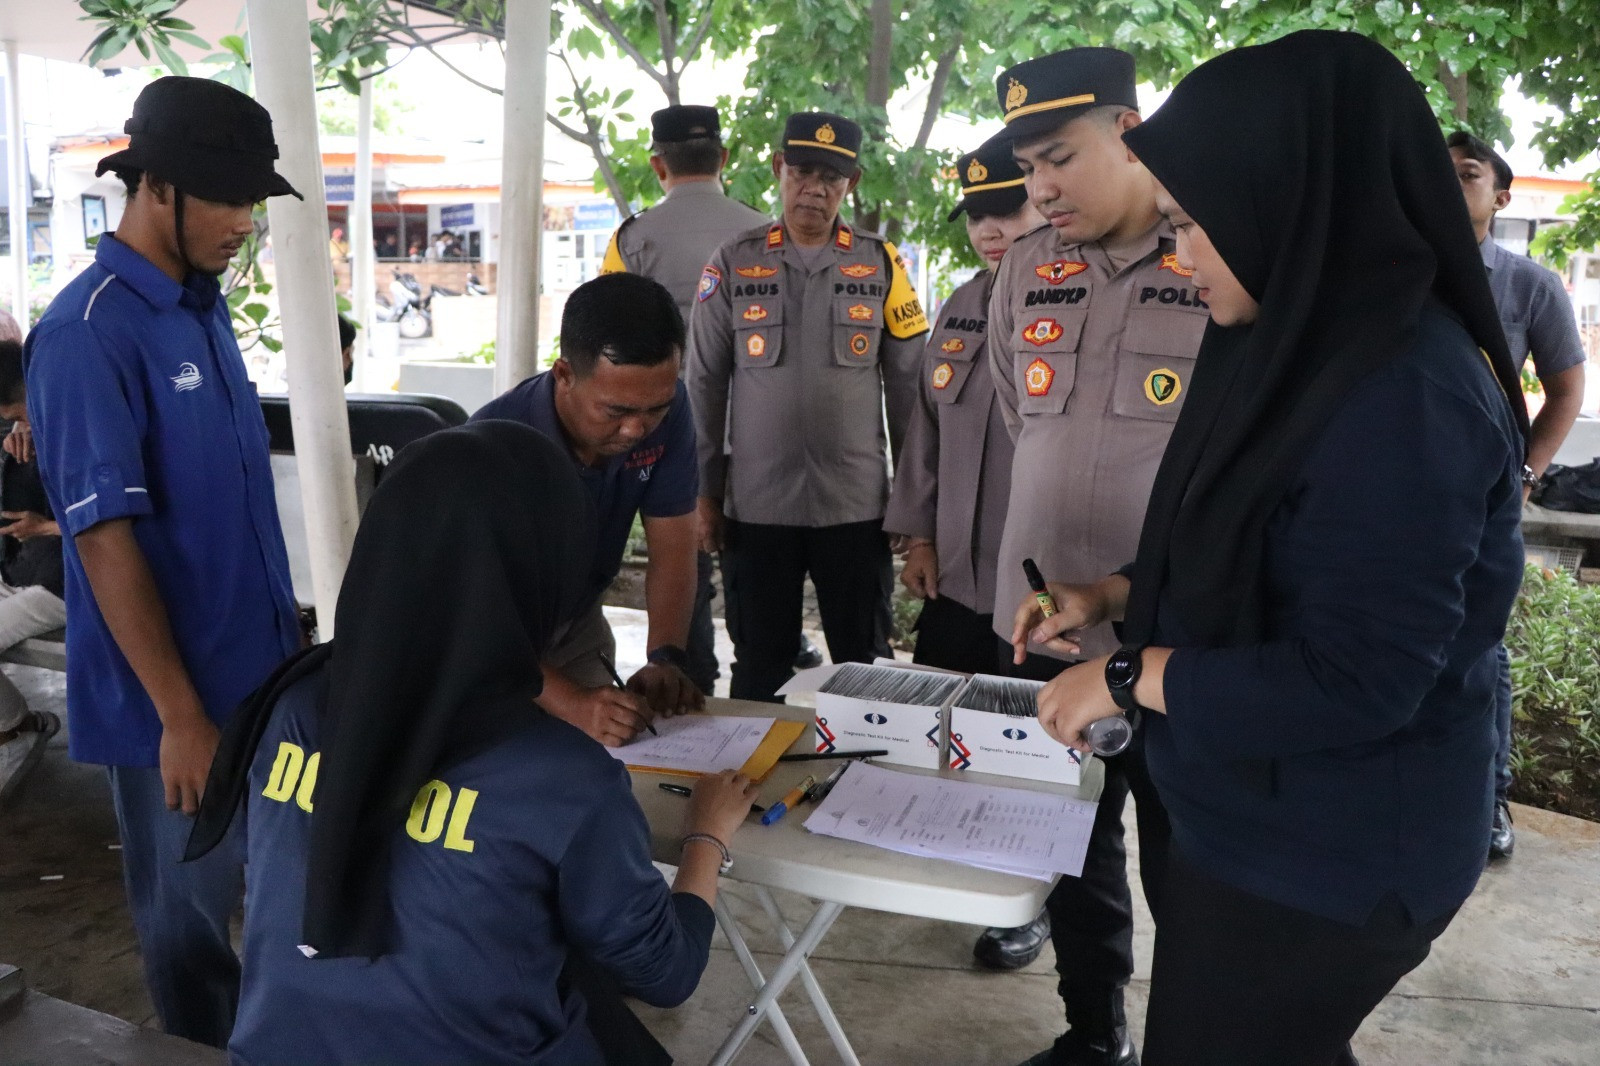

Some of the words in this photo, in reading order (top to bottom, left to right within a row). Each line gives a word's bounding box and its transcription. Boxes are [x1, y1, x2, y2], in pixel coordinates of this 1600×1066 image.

[734, 283, 779, 297] AGUS
[834, 283, 882, 297] POLRI
[1140, 287, 1210, 309] POLR
[944, 316, 987, 333] MADE
[843, 730, 866, 738] Diagnostic
[979, 745, 1003, 753] Diagnostic
